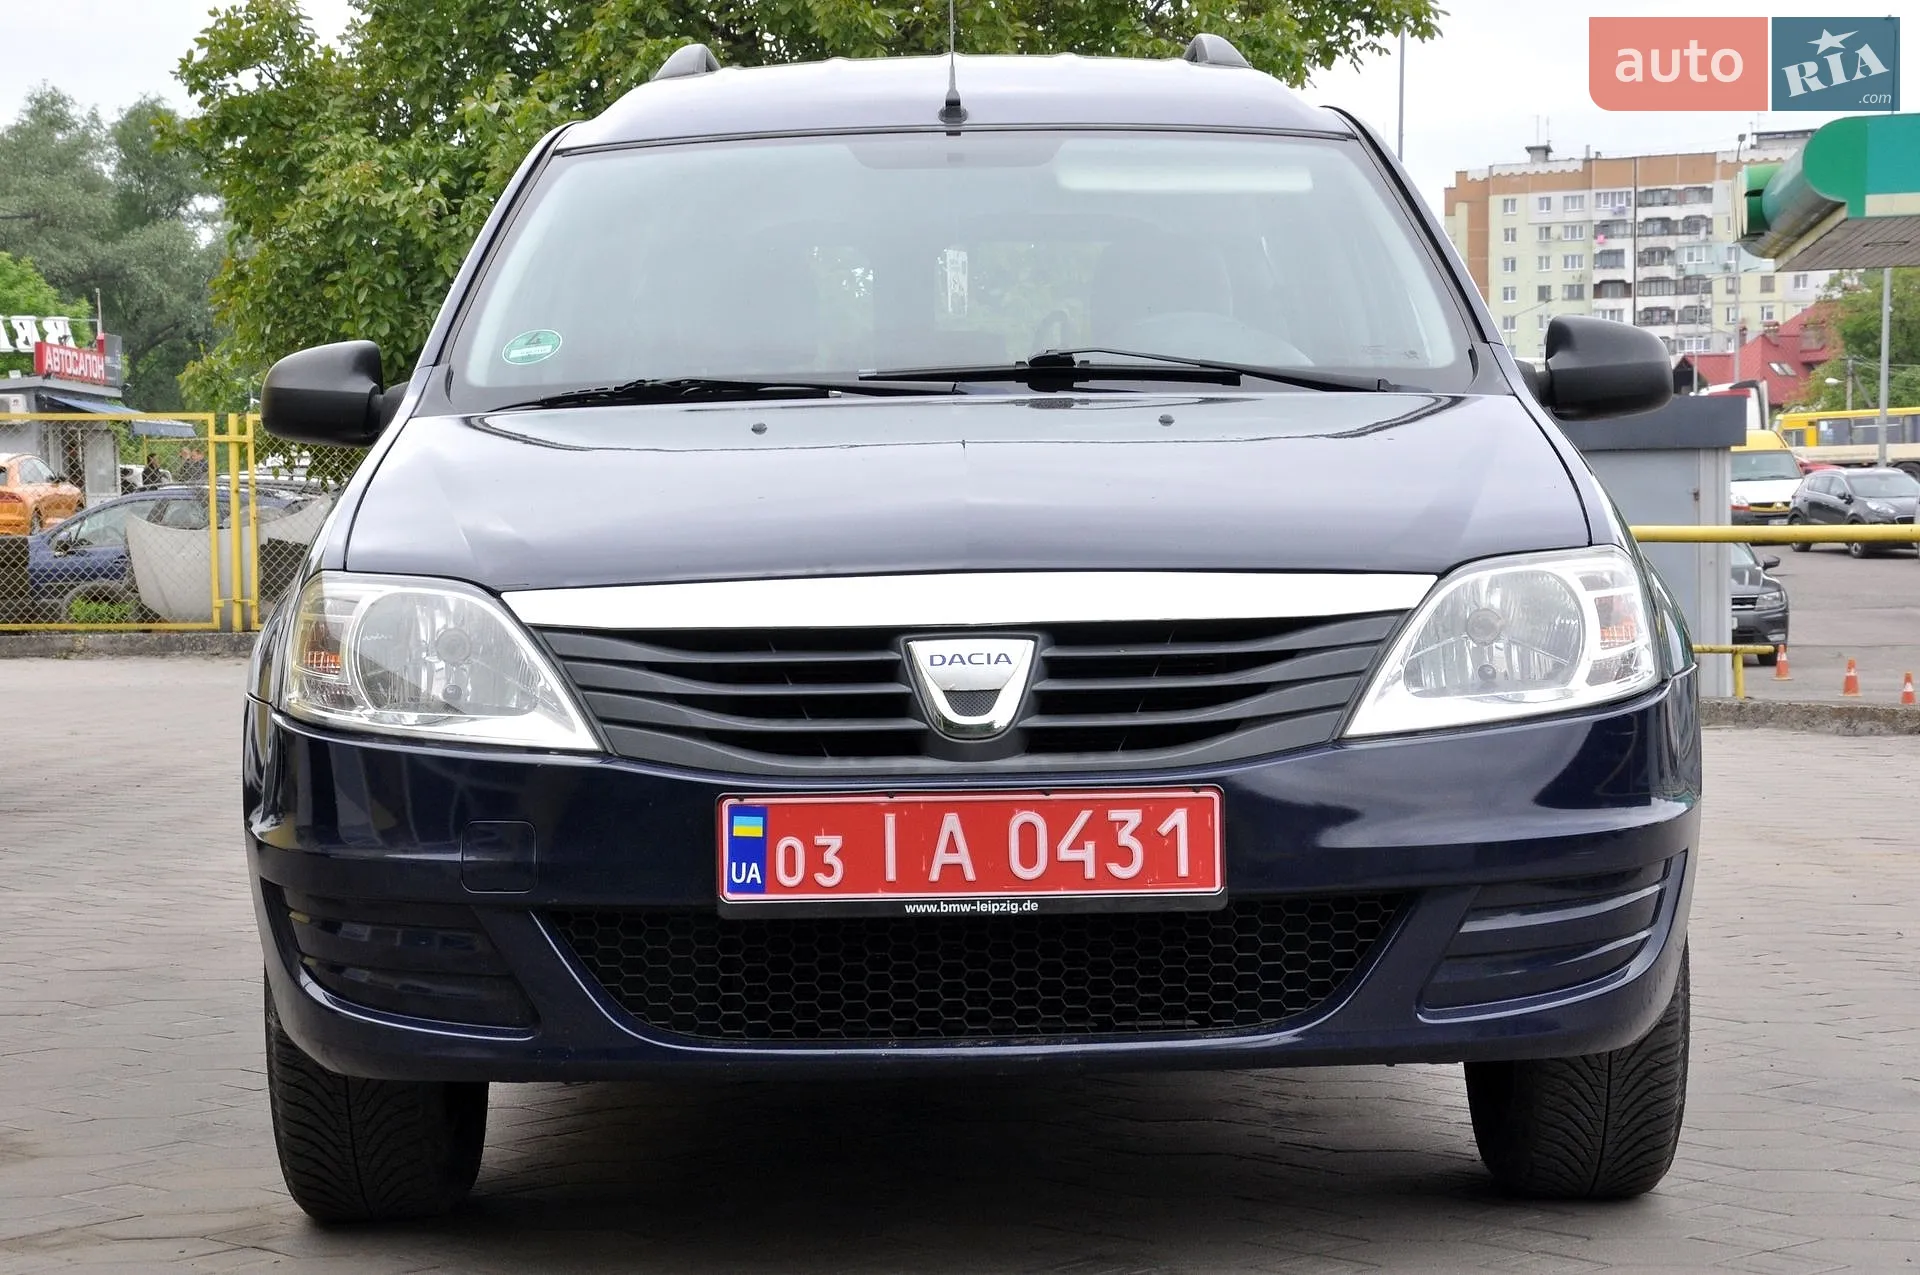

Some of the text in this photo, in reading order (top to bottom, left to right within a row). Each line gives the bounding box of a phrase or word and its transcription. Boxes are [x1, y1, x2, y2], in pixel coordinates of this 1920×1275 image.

[929, 653, 1012, 666] DACIA
[776, 834, 843, 887] 03
[1008, 808, 1190, 880] 0431
[732, 861, 761, 884] UA
[904, 900, 1039, 914] www.bmw-leipzig.de
